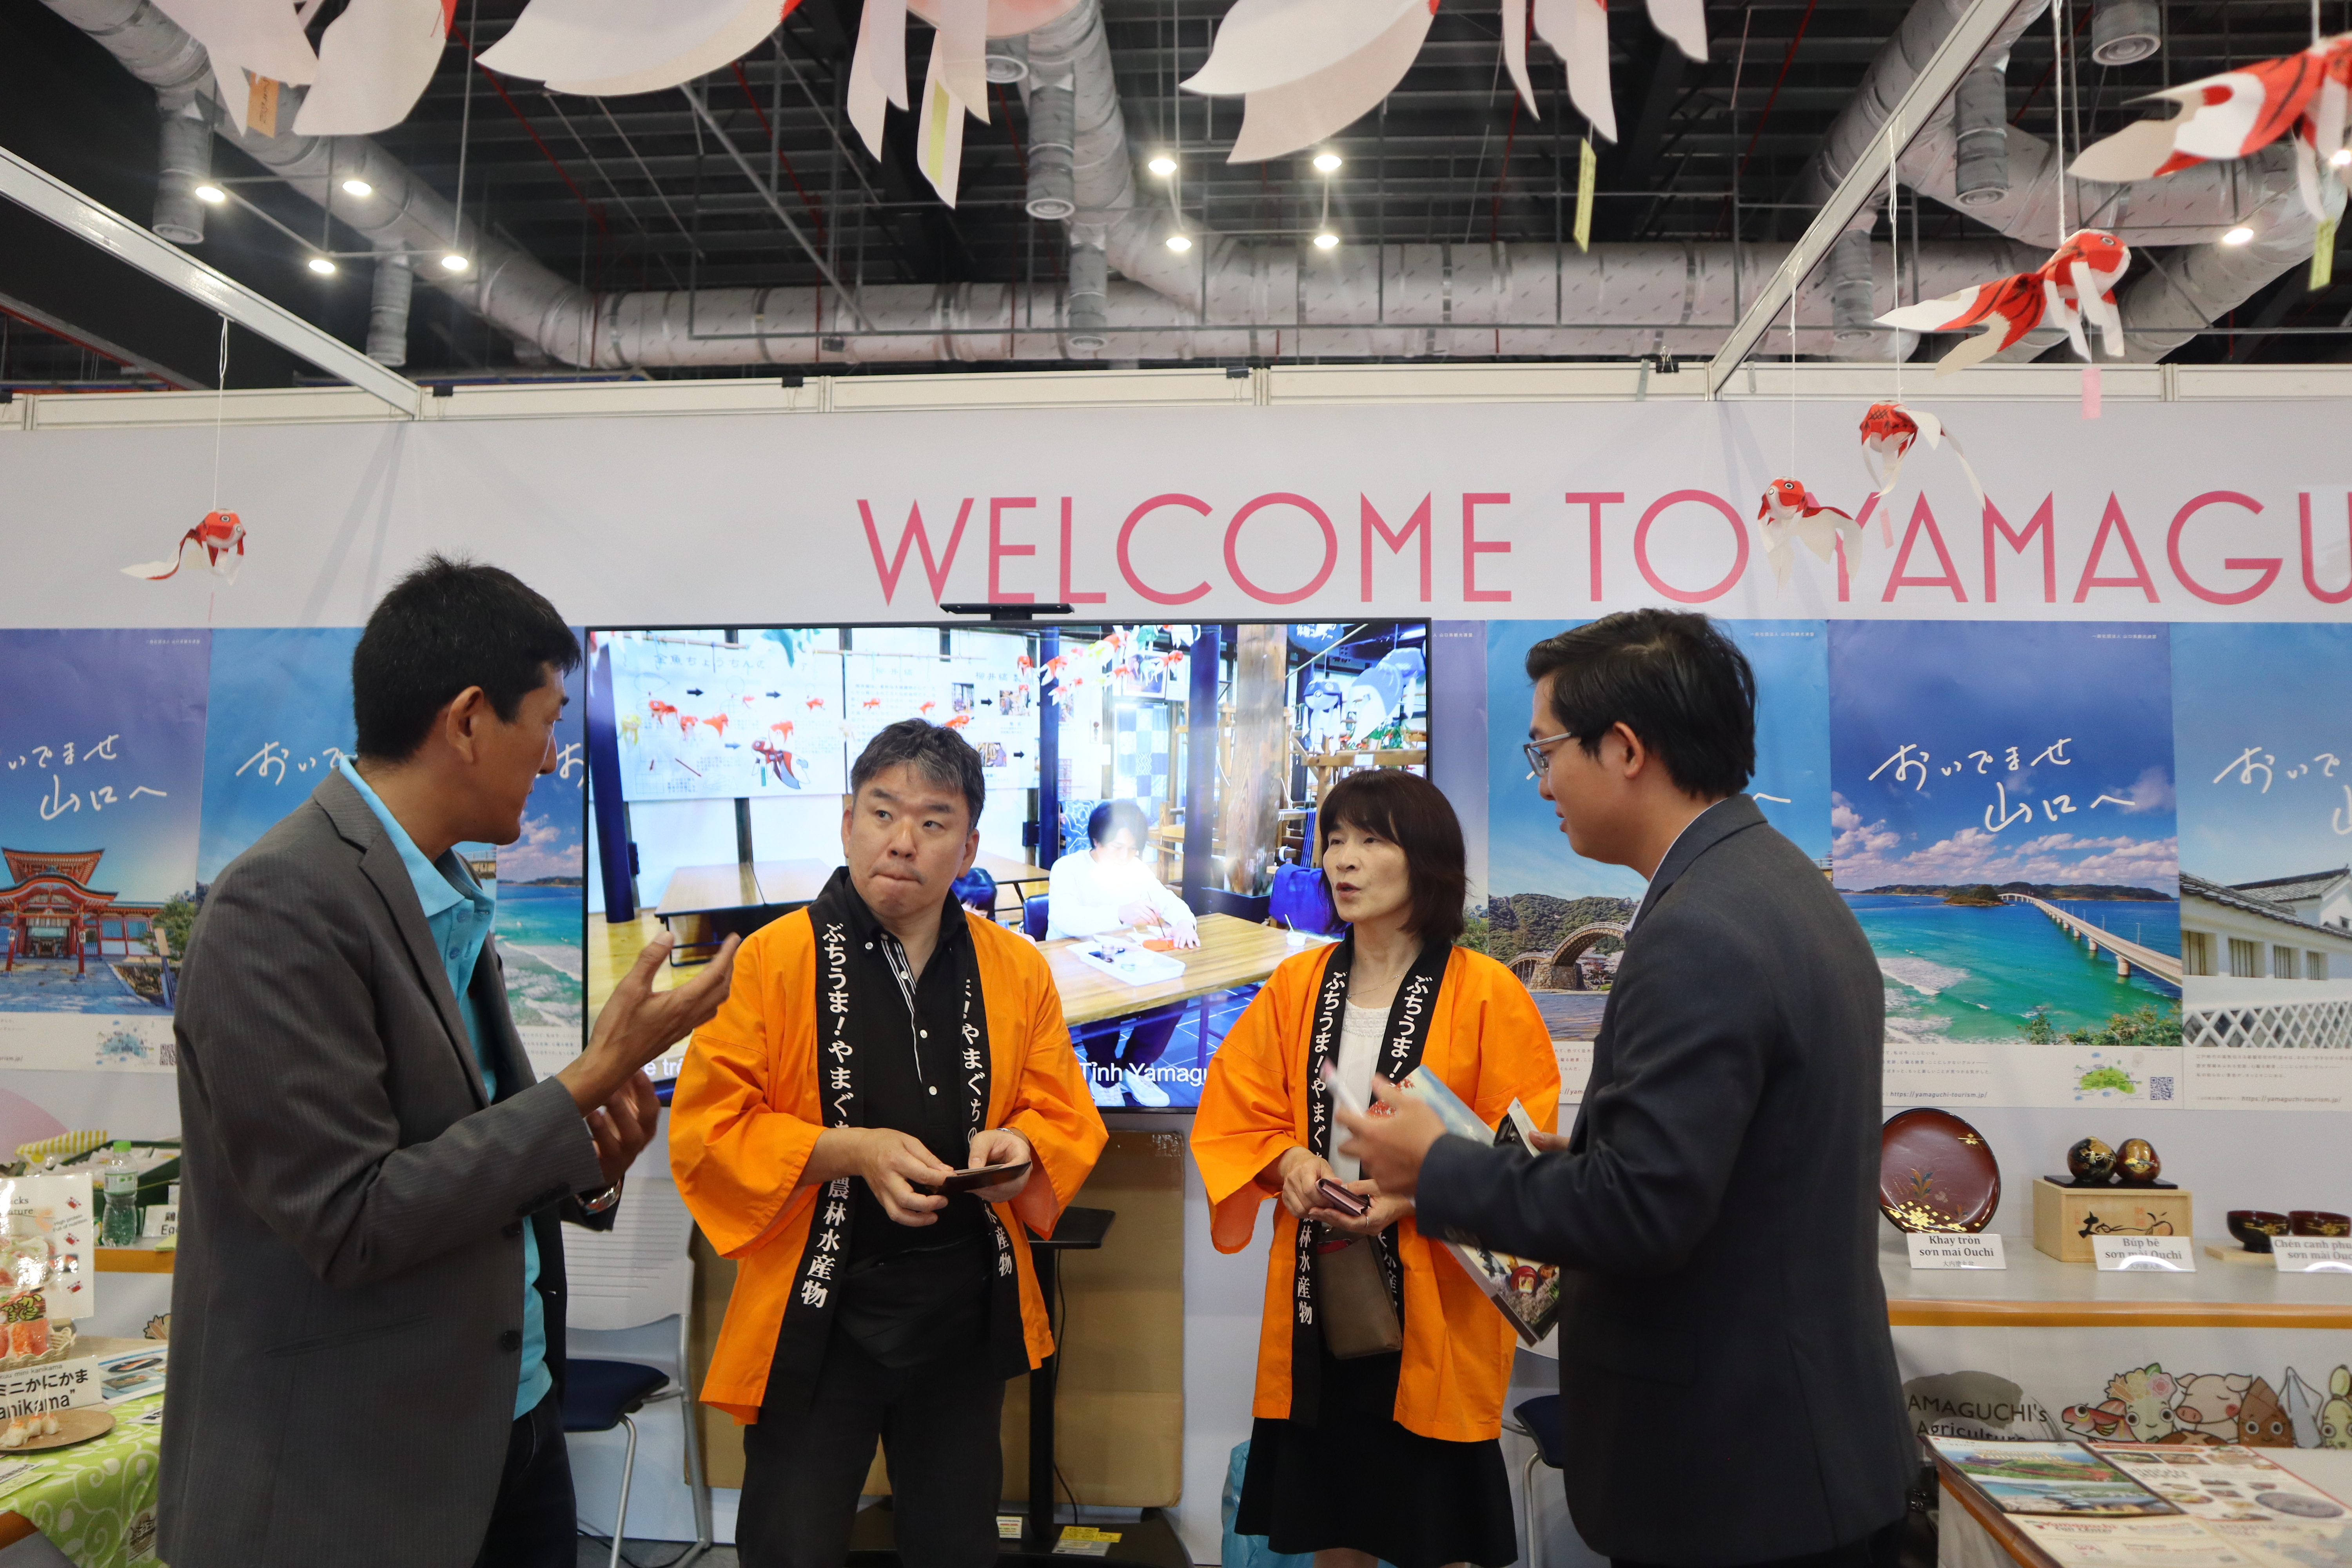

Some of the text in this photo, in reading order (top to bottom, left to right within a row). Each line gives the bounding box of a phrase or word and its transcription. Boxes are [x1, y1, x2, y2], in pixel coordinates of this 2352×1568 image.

[857, 491, 1513, 606] WELCOME
[1565, 490, 1751, 606] TO
[1868, 738, 2072, 791] おいでませ
[1984, 782, 2136, 833] 山口へ
[2241, 1095, 2341, 1103] https://yamaguchi-tourism.jp/
[1929, 1235, 1981, 1246] Khay tròn
[2123, 1238, 2160, 1249] Búp bê
[2274, 1239, 2301, 1248] Chén
[2302, 1240, 2329, 1249] canh
[1964, 1247, 1994, 1257] Ouchi
[2105, 1250, 2125, 1259] sơn
[2151, 1250, 2183, 1260] Ouchi
[31, 1364, 63, 1374] kanikama
